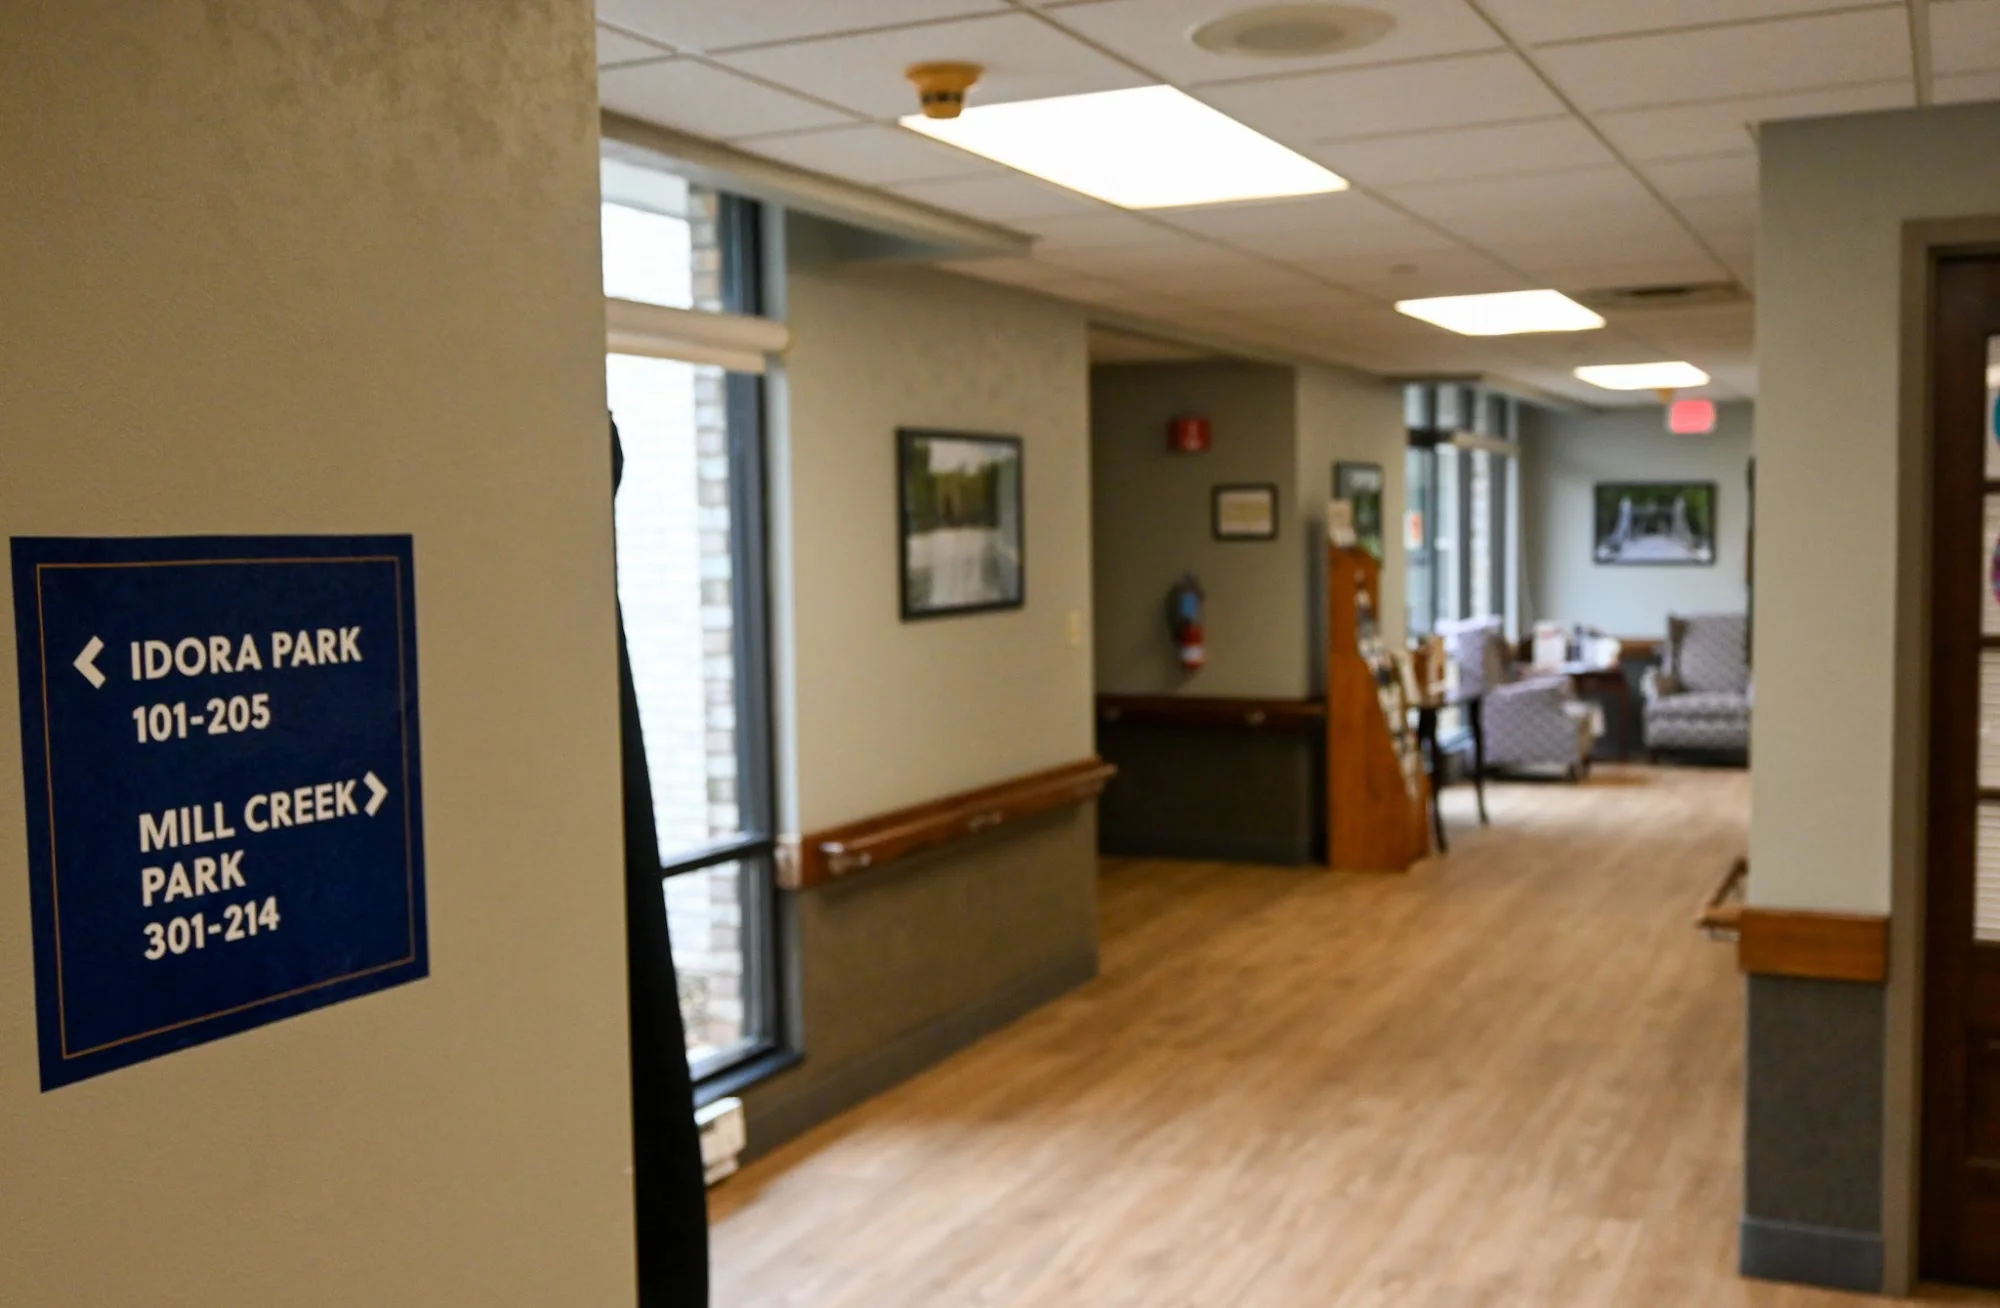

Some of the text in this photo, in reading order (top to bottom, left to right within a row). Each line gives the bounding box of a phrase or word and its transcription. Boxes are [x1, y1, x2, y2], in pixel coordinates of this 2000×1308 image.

[131, 626, 362, 681] IDORA PARK
[133, 693, 270, 743] 101-205
[139, 780, 358, 852] MILL CREEK
[142, 850, 246, 907] PARK
[144, 896, 280, 960] 301-214
